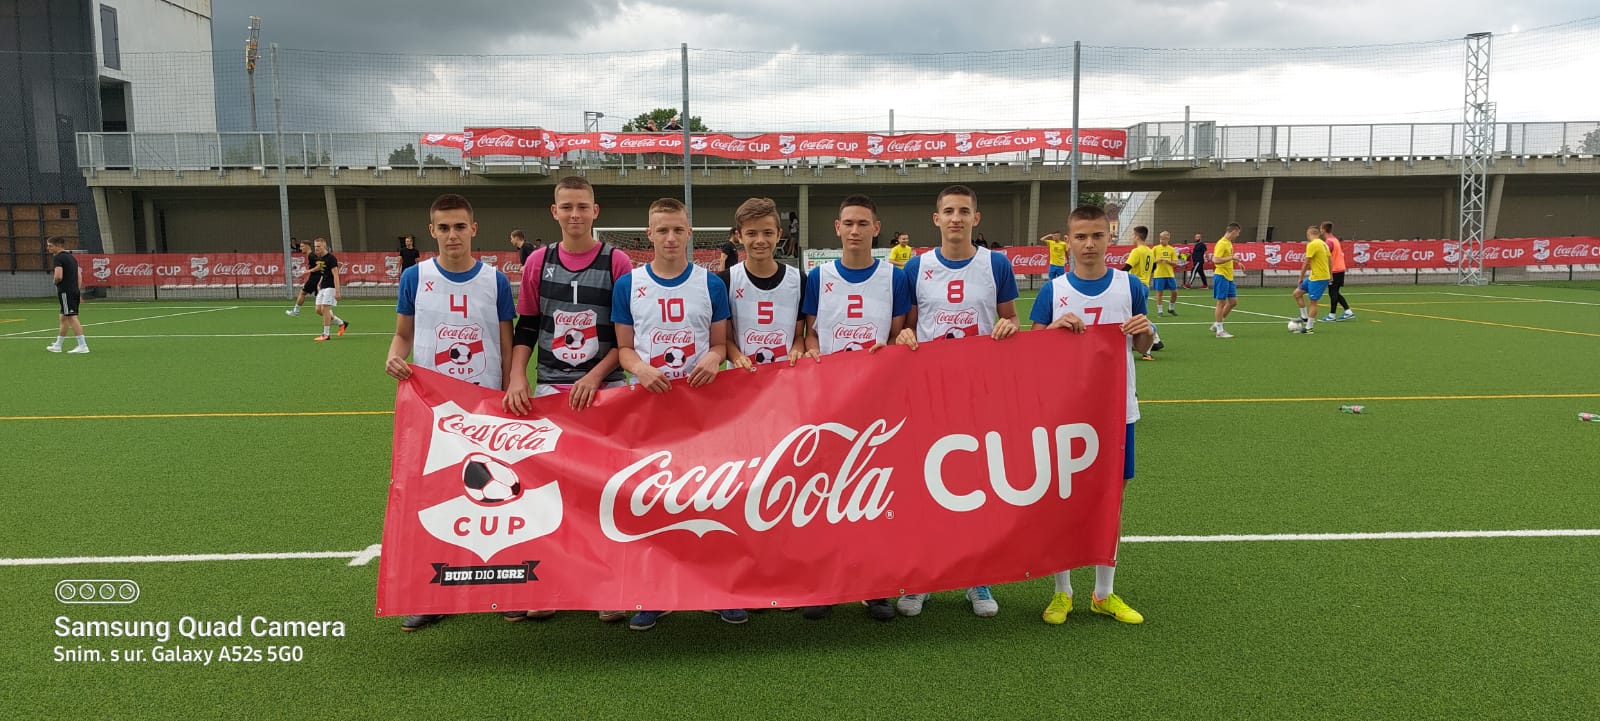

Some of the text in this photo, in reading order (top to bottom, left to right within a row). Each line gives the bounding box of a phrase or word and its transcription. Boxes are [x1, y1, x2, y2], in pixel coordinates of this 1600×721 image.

[518, 139, 541, 148] CUP
[924, 141, 947, 150] CUP
[1014, 136, 1036, 145] CUP
[1101, 139, 1122, 149] CUP
[749, 142, 771, 152] CUP
[837, 142, 858, 151] CUP
[1412, 251, 1434, 261] CUP
[1502, 249, 1524, 259] CUP
[352, 264, 375, 274] CUP
[1145, 255, 1150, 272] 8
[156, 266, 181, 276] CUP
[254, 265, 278, 275] CUP
[570, 281, 578, 304] 1
[947, 280, 964, 303] 8
[450, 294, 468, 318] 4
[658, 298, 684, 322] 10
[847, 294, 863, 318] 2
[757, 301, 773, 324] 5
[1084, 307, 1103, 325] 7
[448, 367, 474, 375] CUP
[437, 414, 554, 452] Coca-Cola
[599, 416, 1099, 543] Coca-Cola CUP
[453, 516, 525, 536] CUP
[444, 569, 525, 581] BUDI DIO IGRE
